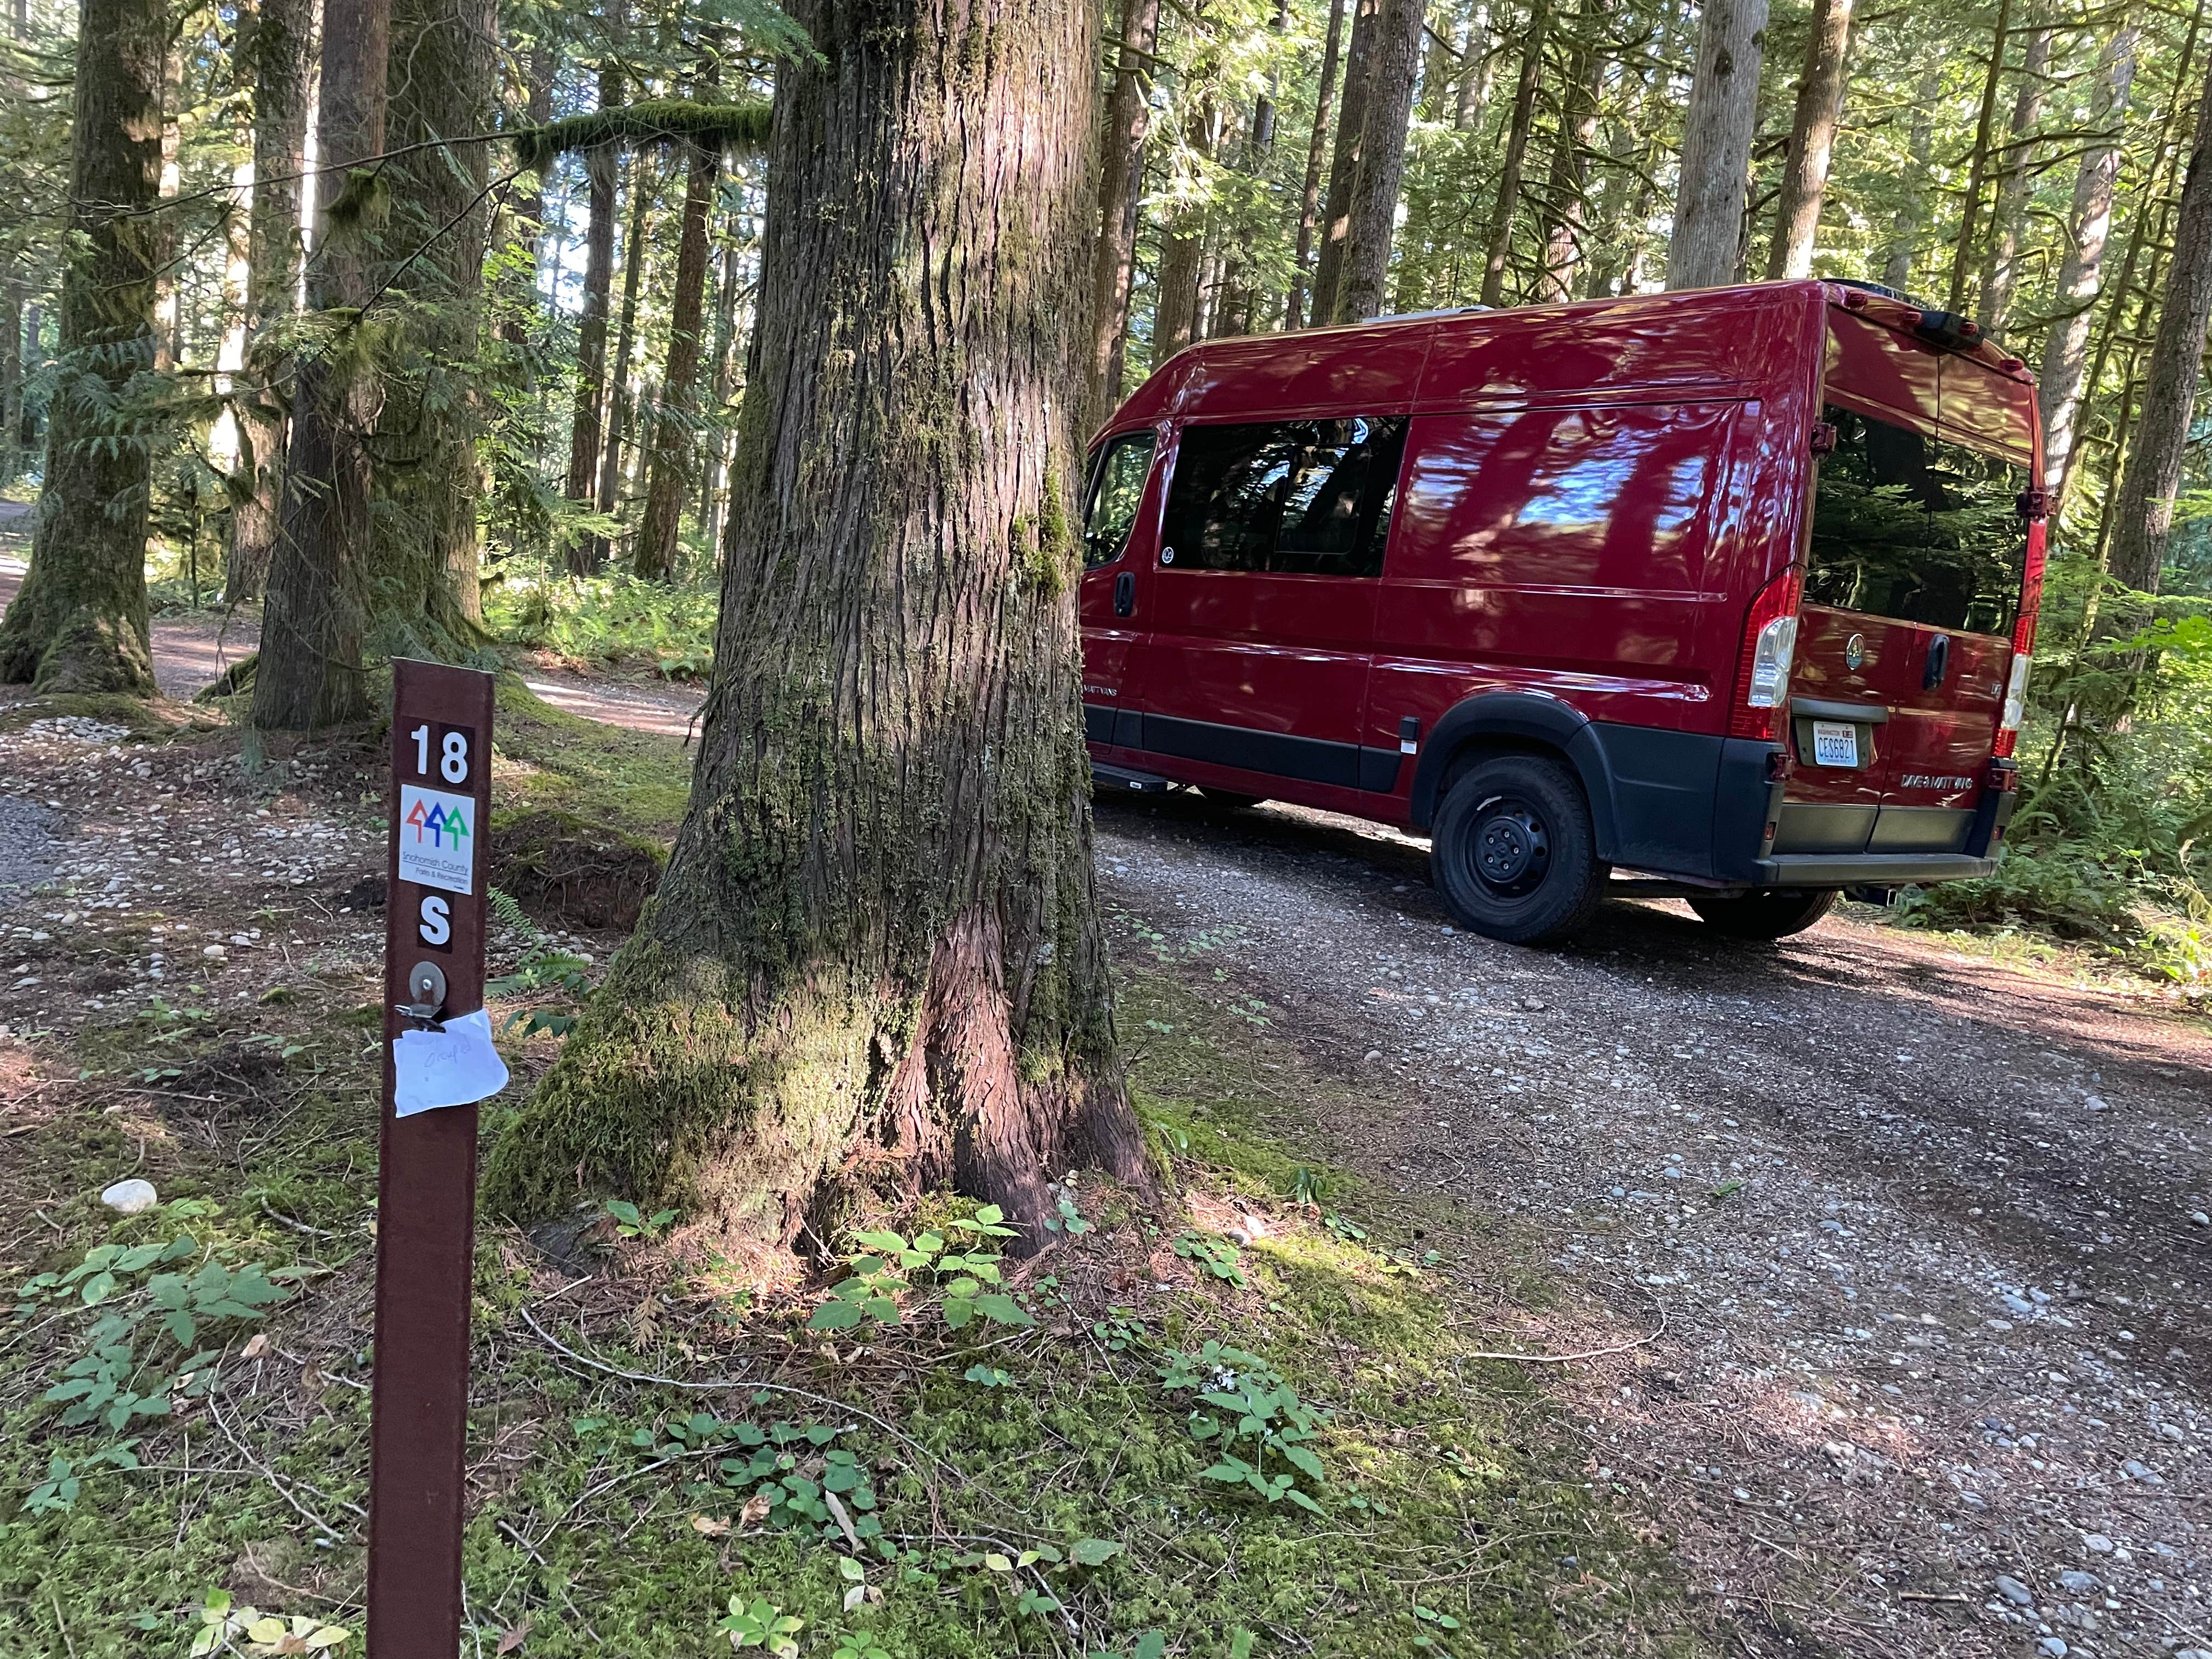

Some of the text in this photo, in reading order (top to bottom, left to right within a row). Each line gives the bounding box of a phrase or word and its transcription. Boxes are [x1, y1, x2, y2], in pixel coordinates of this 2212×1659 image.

[411, 725, 468, 784] 18
[1819, 737, 1854, 760] CES6821
[403, 851, 469, 874] Snohomish County
[420, 896, 449, 945] S
